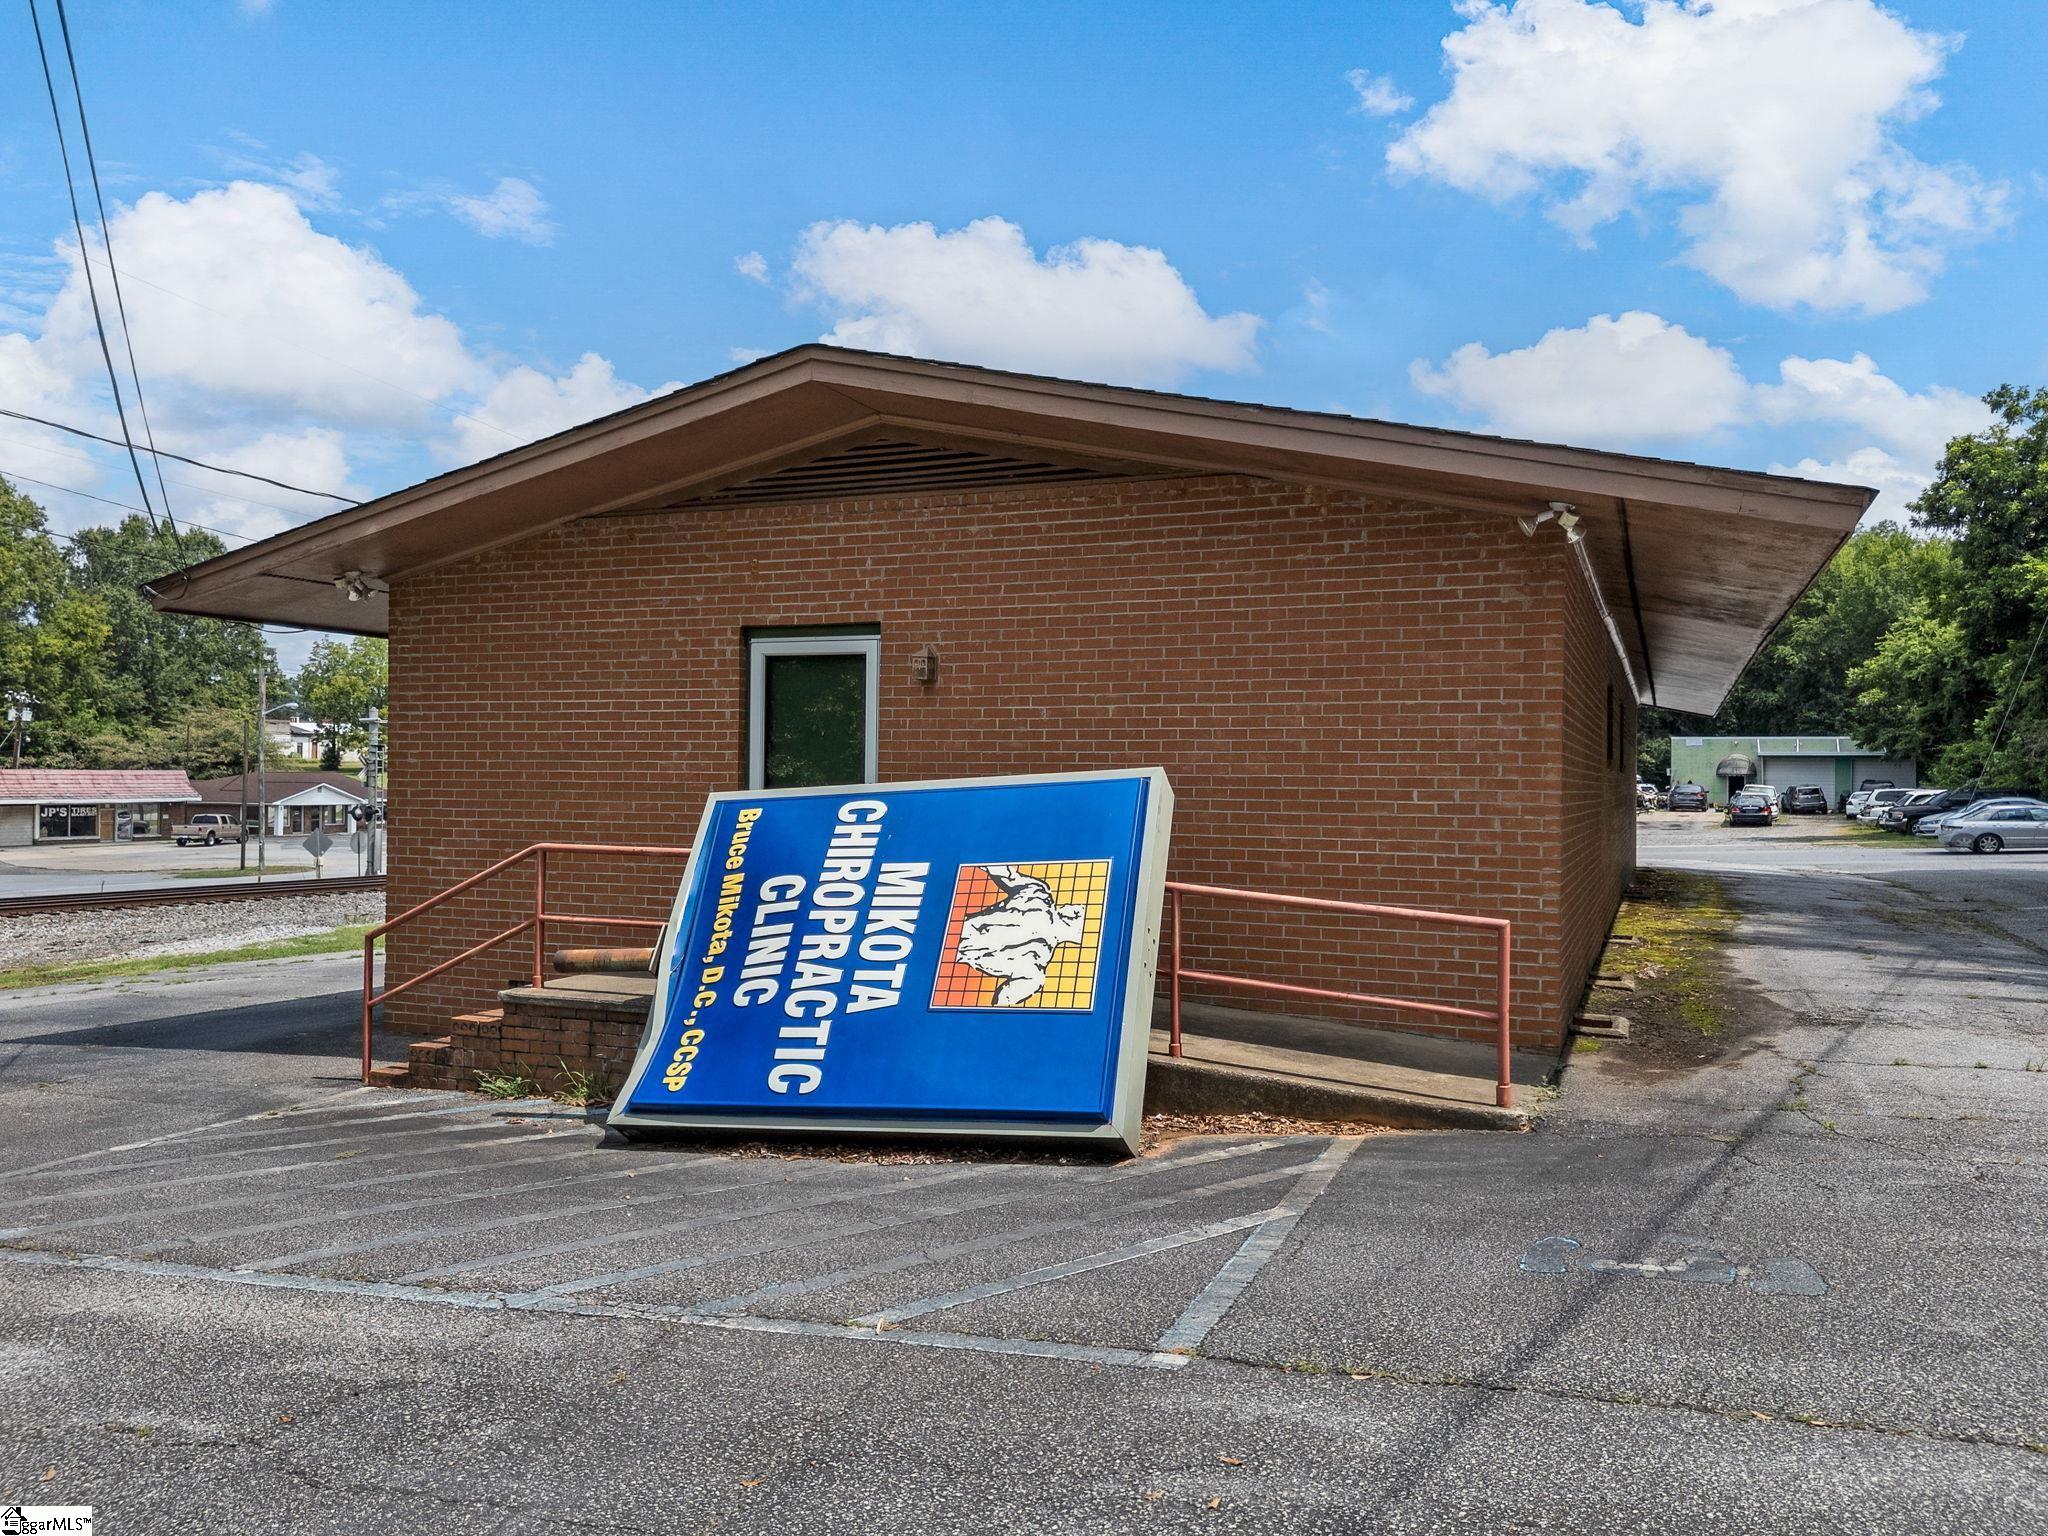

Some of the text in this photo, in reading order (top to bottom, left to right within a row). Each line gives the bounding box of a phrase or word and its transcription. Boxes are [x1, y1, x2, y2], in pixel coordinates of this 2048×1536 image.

[41, 807, 68, 818] JP'S
[725, 807, 764, 871] Bruce
[702, 872, 746, 964] Mikota,
[733, 874, 807, 1008] CLINIC
[767, 800, 888, 1094] CHIROPRACTIC
[846, 862, 931, 1014] MIKOTA
[662, 1029, 705, 1093] CCSP
